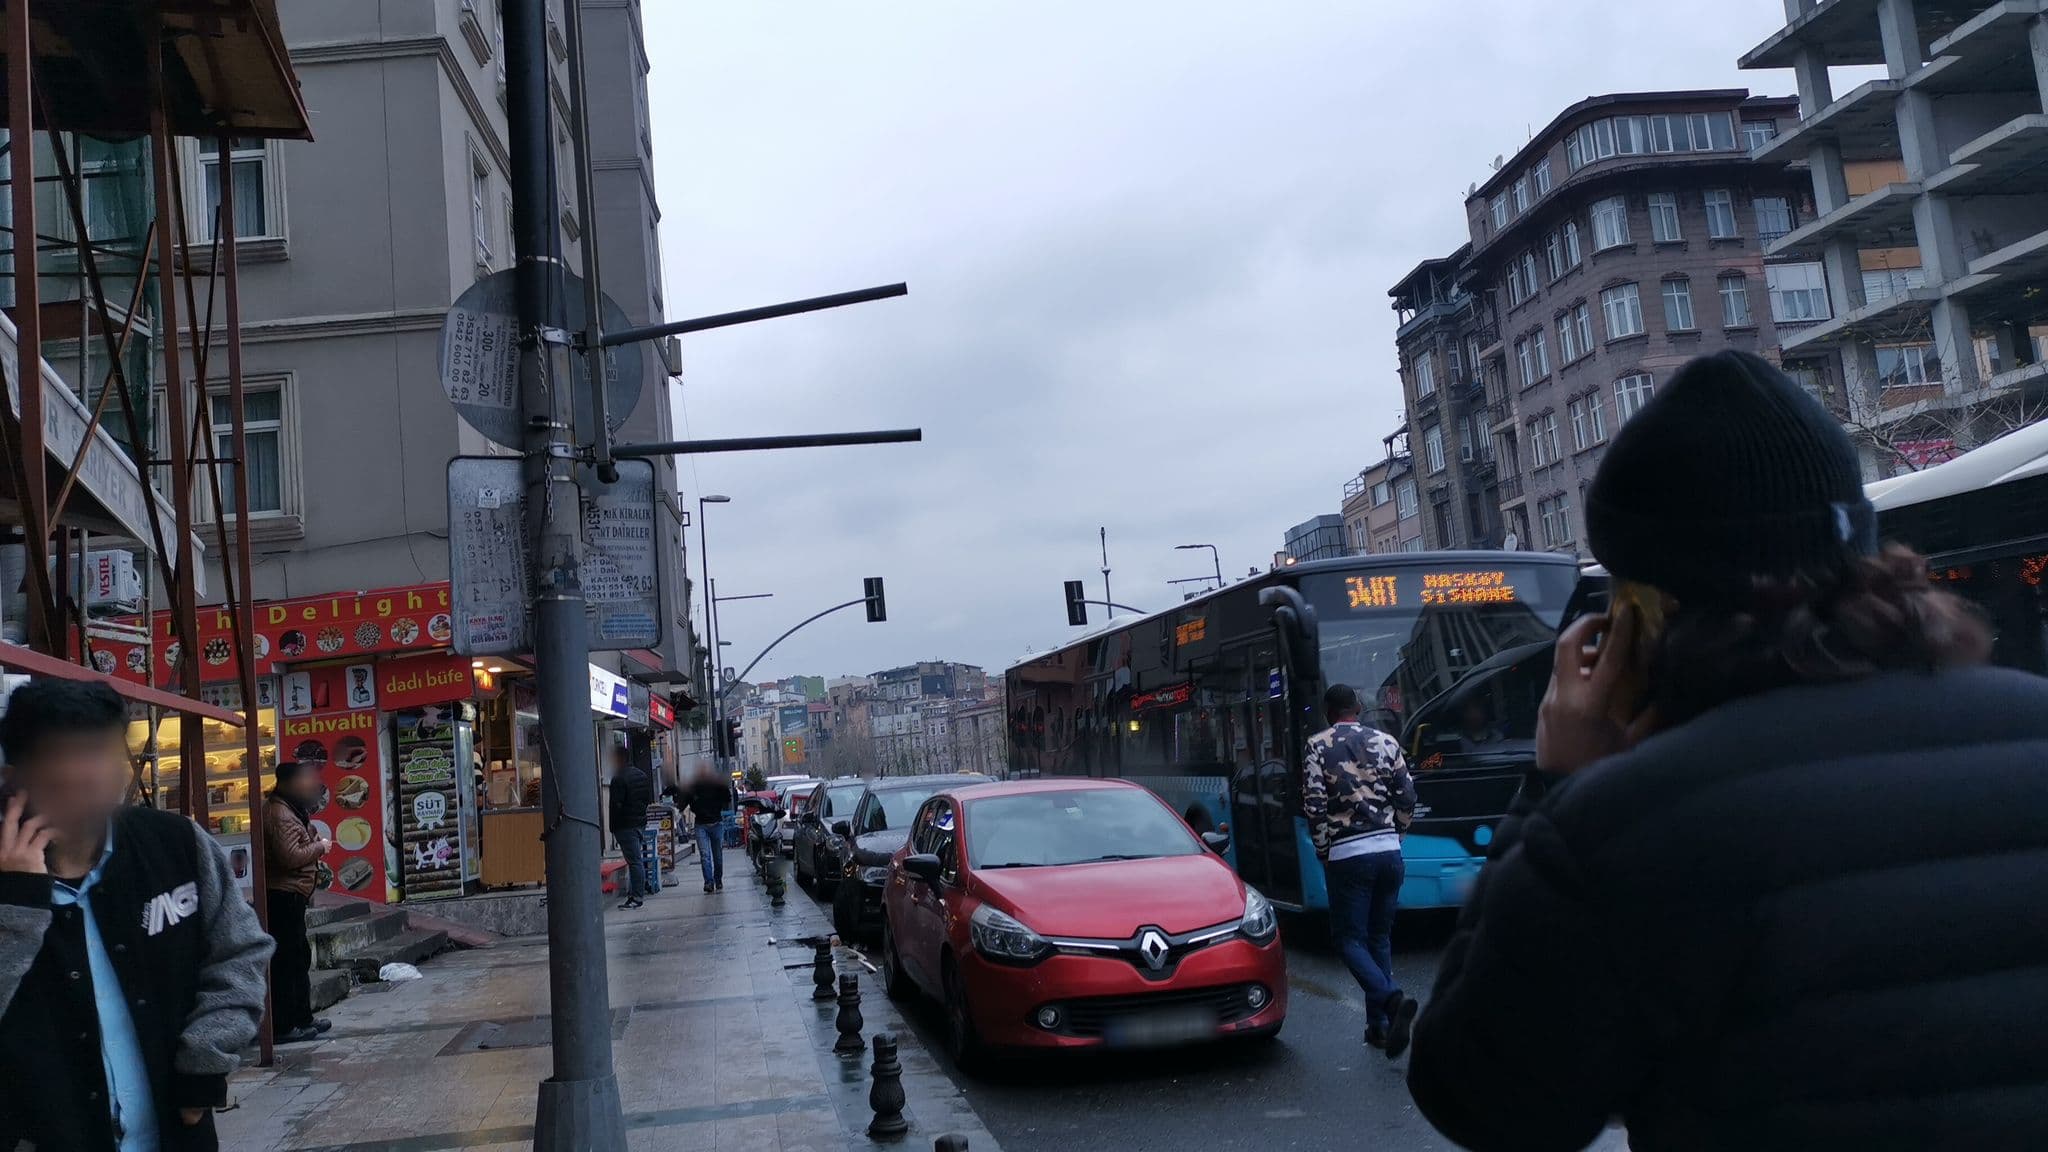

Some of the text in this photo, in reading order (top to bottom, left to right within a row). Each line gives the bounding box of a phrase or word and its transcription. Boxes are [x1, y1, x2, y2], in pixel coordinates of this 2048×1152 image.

[482, 330, 494, 352] 300
[450, 313, 465, 399] 0542 600 00 44
[463, 346, 472, 366] 717
[460, 386, 469, 401] 63
[478, 382, 490, 397] 20
[612, 525, 650, 539] DAİRELER
[99, 554, 111, 597] VESTEL
[642, 575, 653, 591] 63
[268, 590, 448, 625] Delight
[386, 668, 464, 693] dadı büfe
[285, 713, 373, 736] kahvaltı
[416, 798, 442, 811] SÜT
